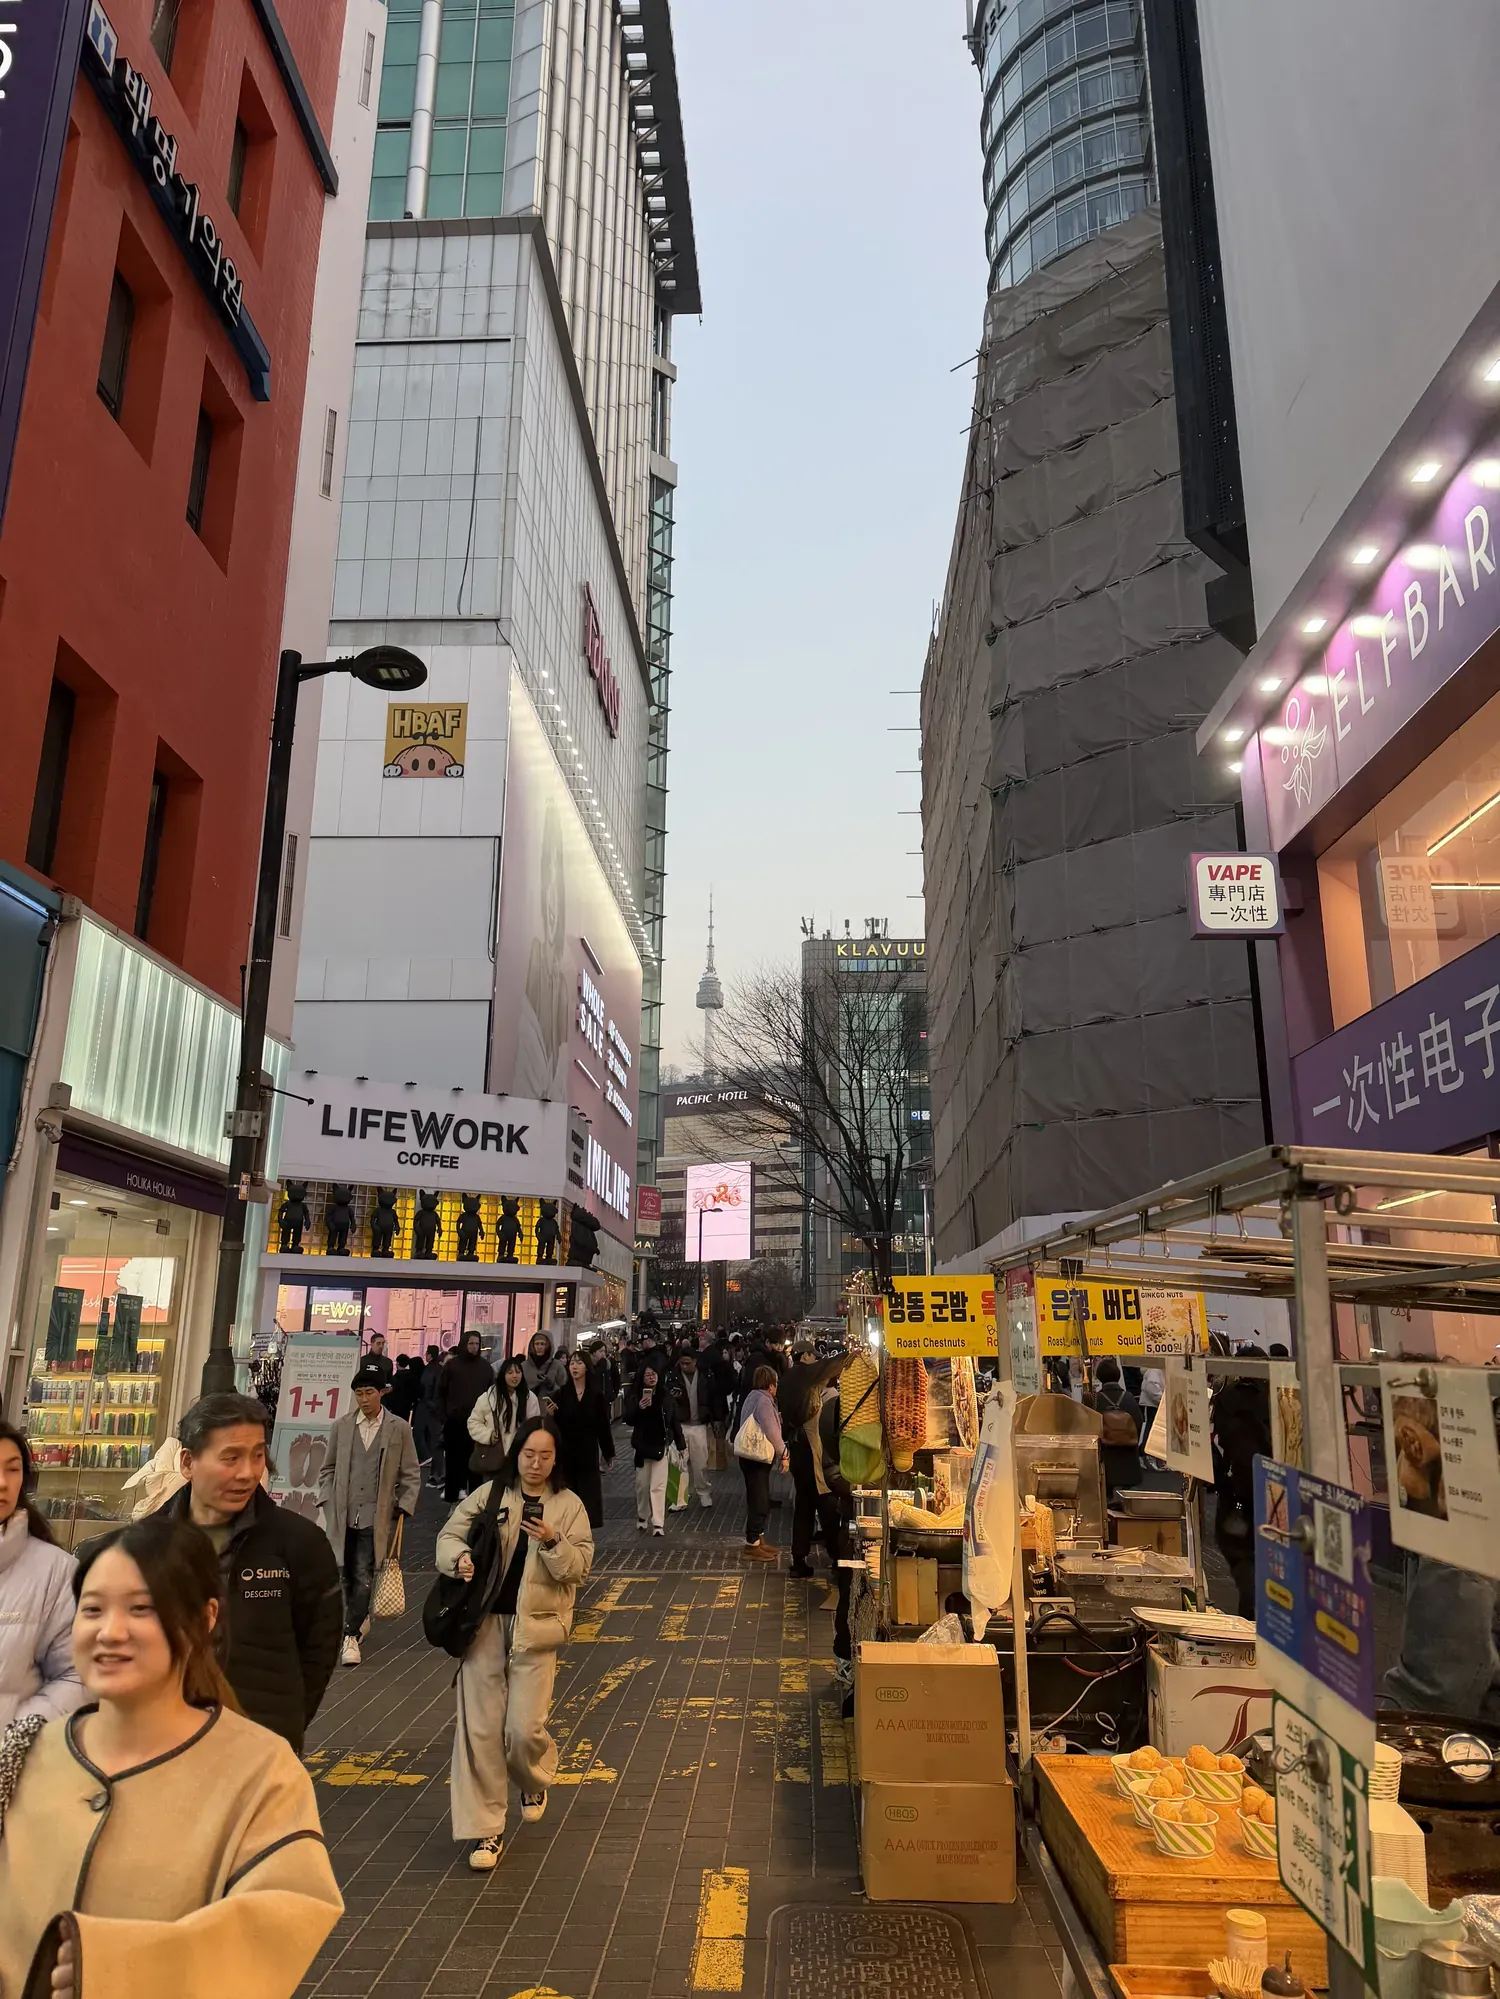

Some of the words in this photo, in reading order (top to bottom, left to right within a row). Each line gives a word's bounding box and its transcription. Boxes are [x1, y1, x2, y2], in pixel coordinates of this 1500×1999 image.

[124, 58, 243, 327] 백명기의원
[1331, 505, 1496, 742] ELFBAR
[392, 708, 462, 738] HBAF
[1207, 865, 1262, 881] VAPE
[1208, 884, 1265, 902] 專門店
[1210, 905, 1269, 922] 一次性
[837, 943, 926, 957] KLAVUU
[582, 968, 605, 1028] WHOLE
[580, 1003, 604, 1059] SALE
[676, 1093, 713, 1106] PACIFIC
[717, 1090, 749, 1103] HOTEL
[321, 1103, 530, 1154] LIFEWORK
[397, 1150, 460, 1169] COFFEE
[586, 1133, 630, 1220] IMILINE
[126, 1172, 153, 1193] HOLIKA
[151, 1180, 177, 1200] HOLIKA
[693, 1183, 742, 1209] 2026
[1140, 1291, 1166, 1299] GINKGO
[887, 1291, 925, 1323] 명동
[930, 1290, 976, 1322] 군밤.
[896, 1337, 921, 1349] Roast
[923, 1337, 966, 1349] Chestnuts
[1117, 1334, 1143, 1346] Squid
[1146, 1342, 1183, 1353] 5,000원
[289, 1386, 340, 1420] 1+1
[244, 1590, 281, 1599] DESCENTE
[880, 1690, 905, 1699] HBQS
[876, 1718, 907, 1731] AAA
[907, 1719, 925, 1731] QUICK
[889, 1808, 915, 1819] HBQS
[884, 1838, 916, 1852] AAA
